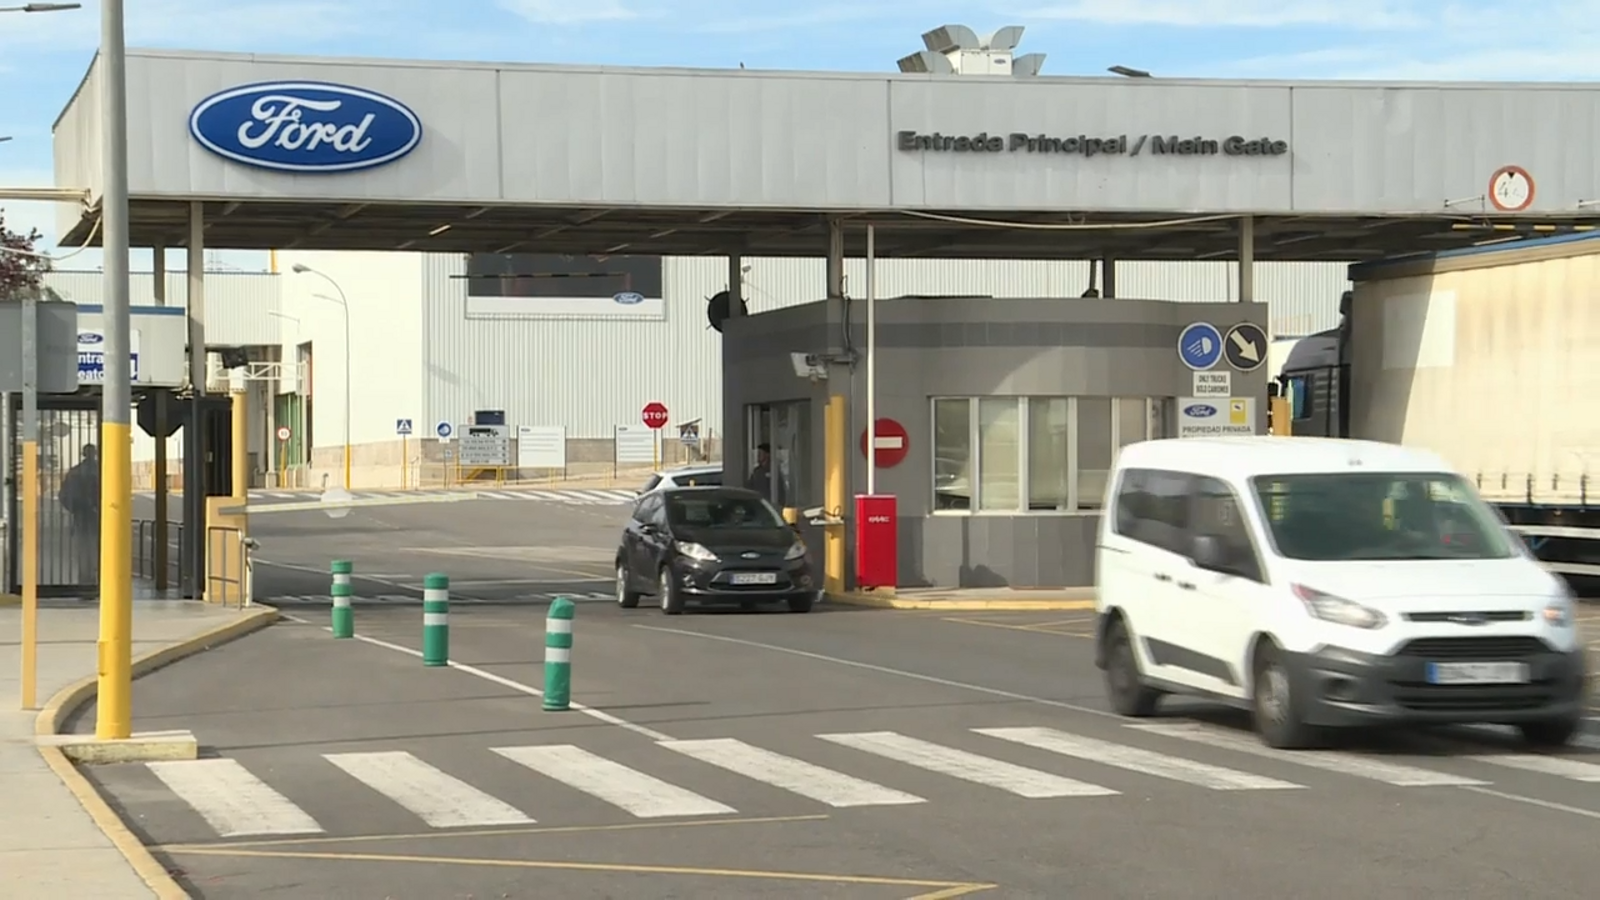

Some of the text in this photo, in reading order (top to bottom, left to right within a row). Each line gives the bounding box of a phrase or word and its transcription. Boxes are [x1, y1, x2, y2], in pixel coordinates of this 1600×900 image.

[237, 94, 376, 153] Ford
[896, 130, 1004, 153] Entrada
[1008, 133, 1127, 158] Principal
[1151, 135, 1218, 156] Main
[1223, 136, 1289, 156] Gate
[642, 411, 668, 420] STOP
[1182, 425, 1251, 434] PROPIEDAD PRIVADA
